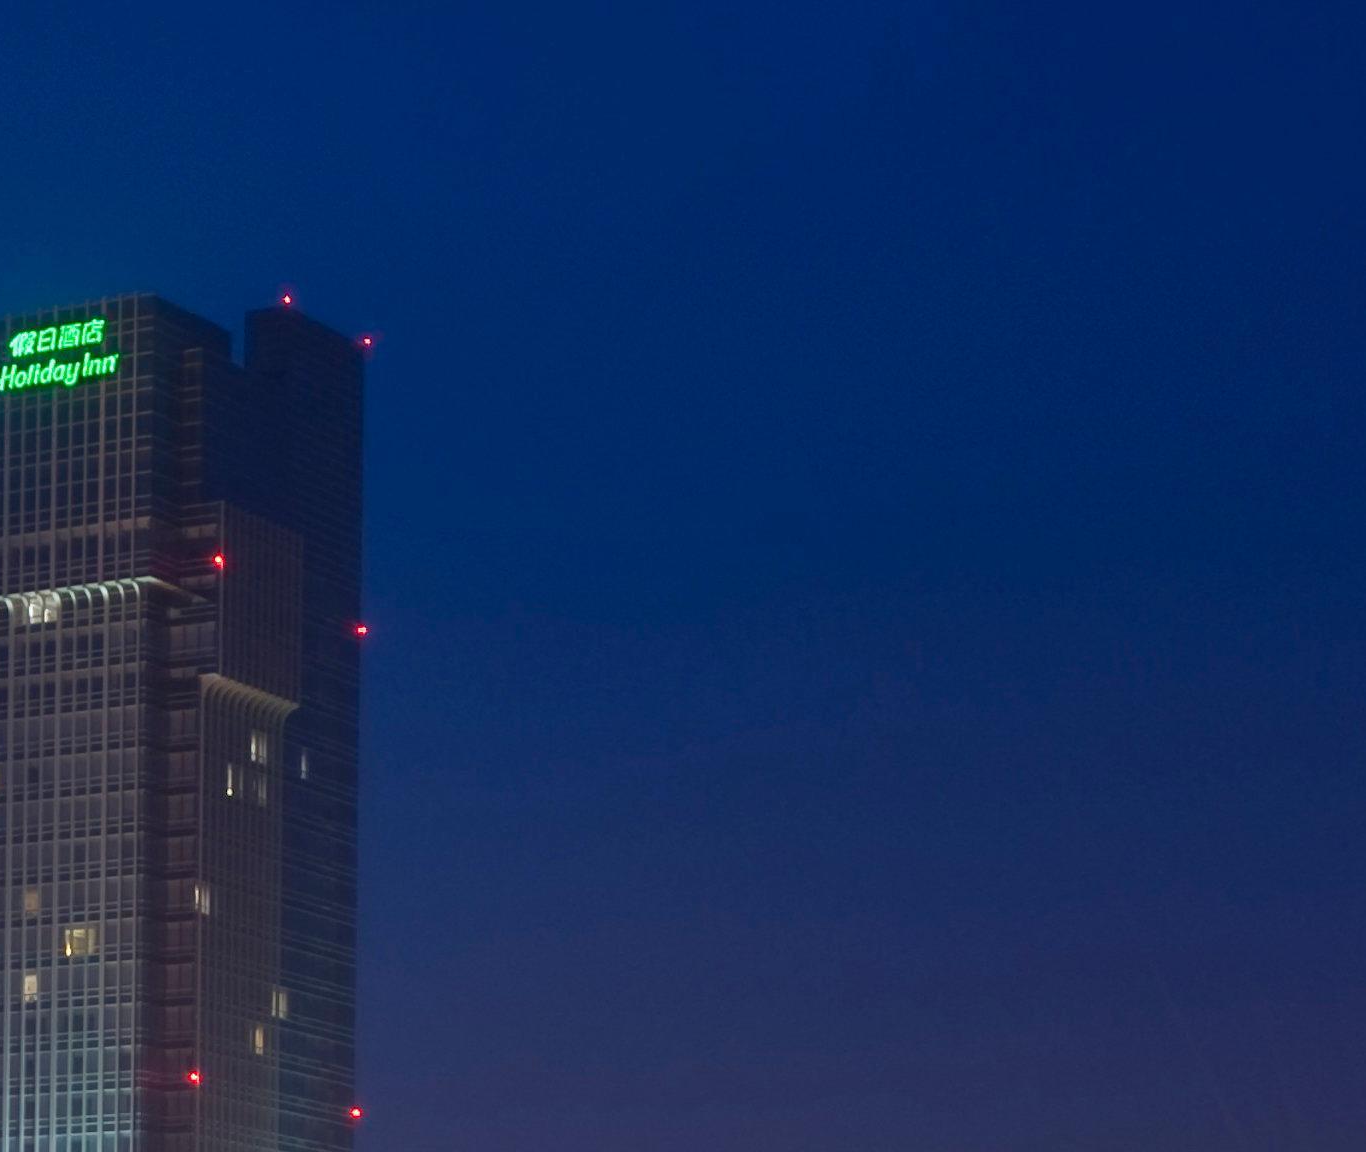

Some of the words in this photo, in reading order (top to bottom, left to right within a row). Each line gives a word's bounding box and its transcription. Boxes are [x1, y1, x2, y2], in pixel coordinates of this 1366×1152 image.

[9, 318, 105, 357] 假日酒店
[82, 352, 118, 377] Inn
